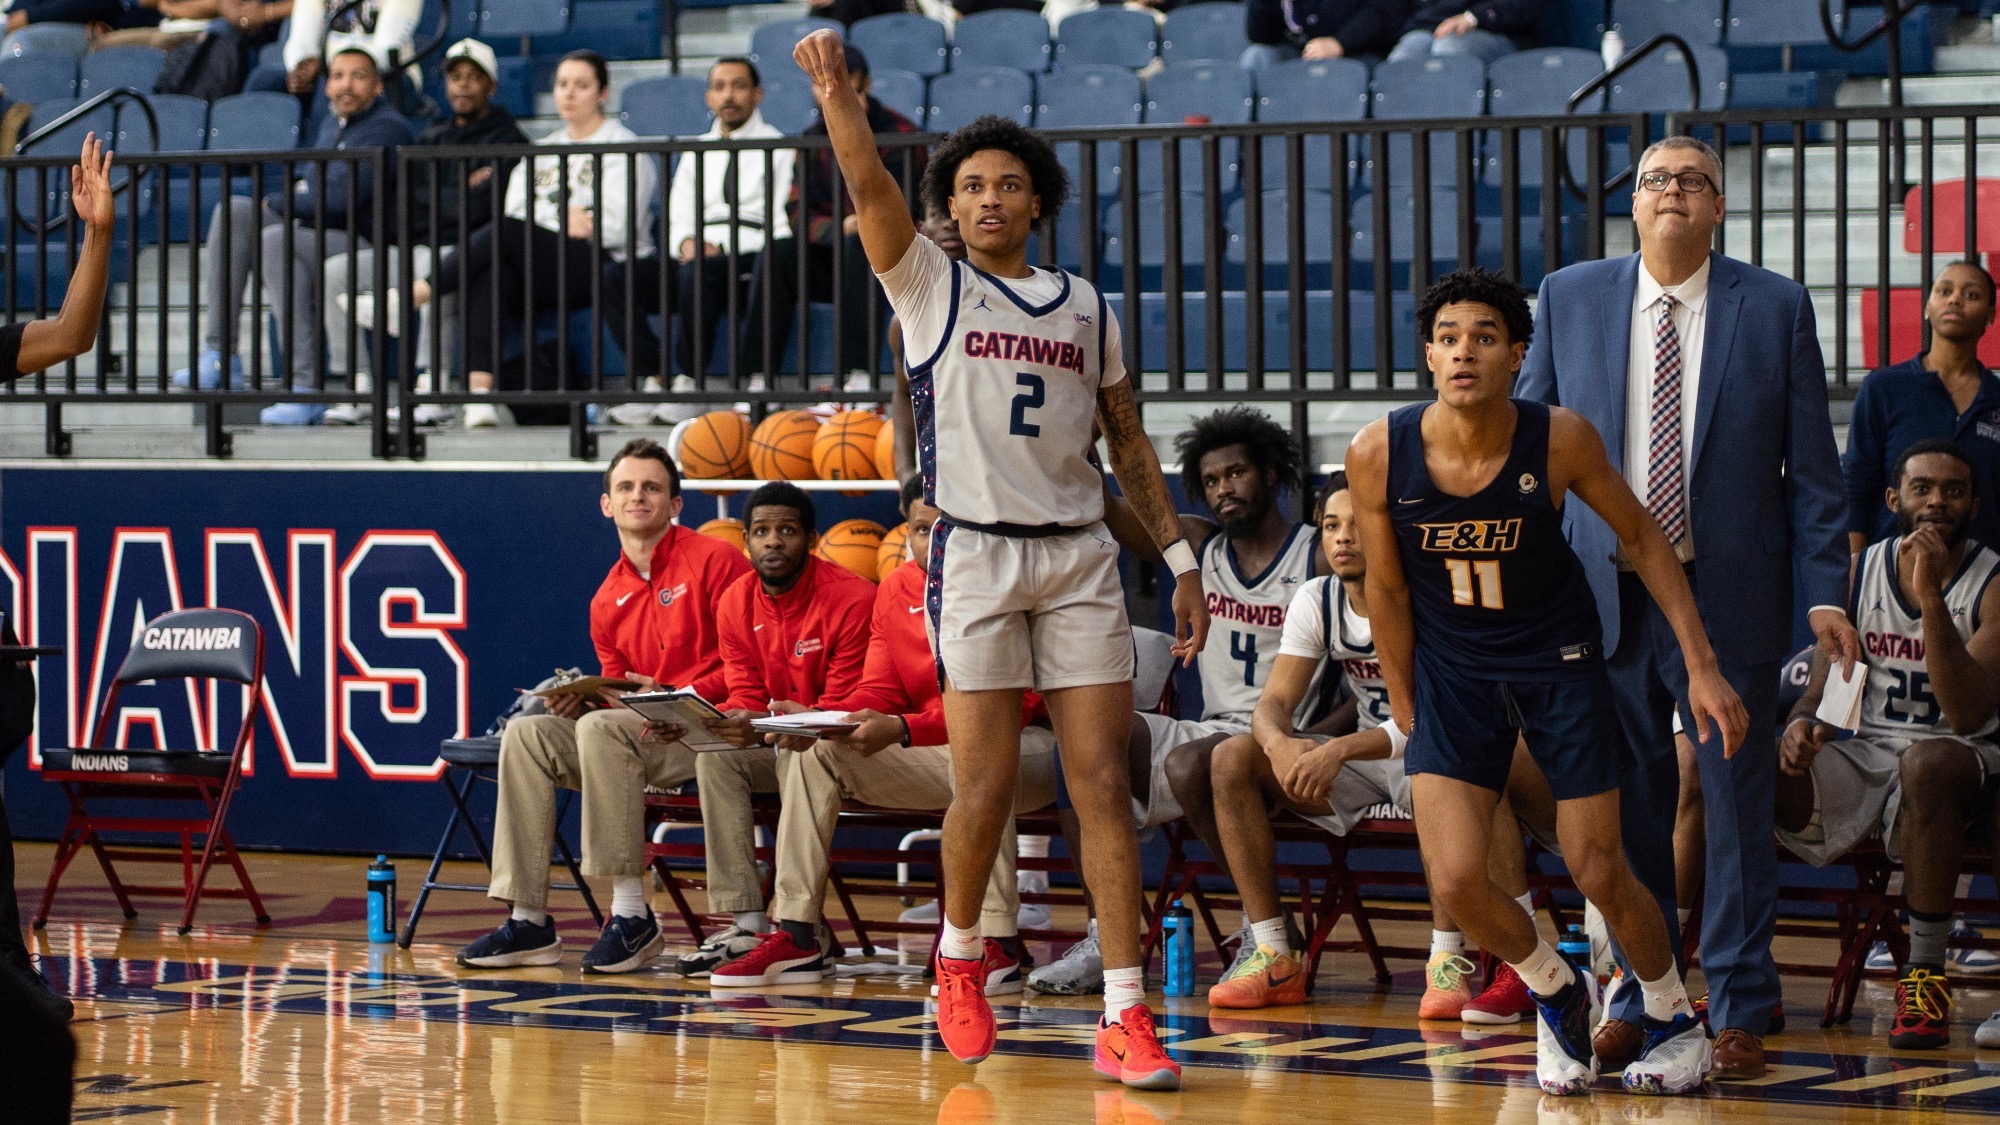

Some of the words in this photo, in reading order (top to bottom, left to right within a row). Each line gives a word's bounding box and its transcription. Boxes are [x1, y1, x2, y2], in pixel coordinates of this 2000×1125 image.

[1075, 312, 1092, 325] SAC
[964, 330, 1085, 376] CATAWBA
[1009, 372, 1045, 438] 2
[1413, 517, 1523, 552] E&H
[1444, 558, 1504, 610] 11
[1206, 591, 1289, 629] CATAWB
[0, 525, 469, 781] IANS
[143, 626, 242, 651] CATAWBA
[1230, 630, 1259, 687] 4
[1865, 631, 1926, 662] CATA
[1884, 667, 1942, 725] 25
[71, 754, 129, 772] INDIANS
